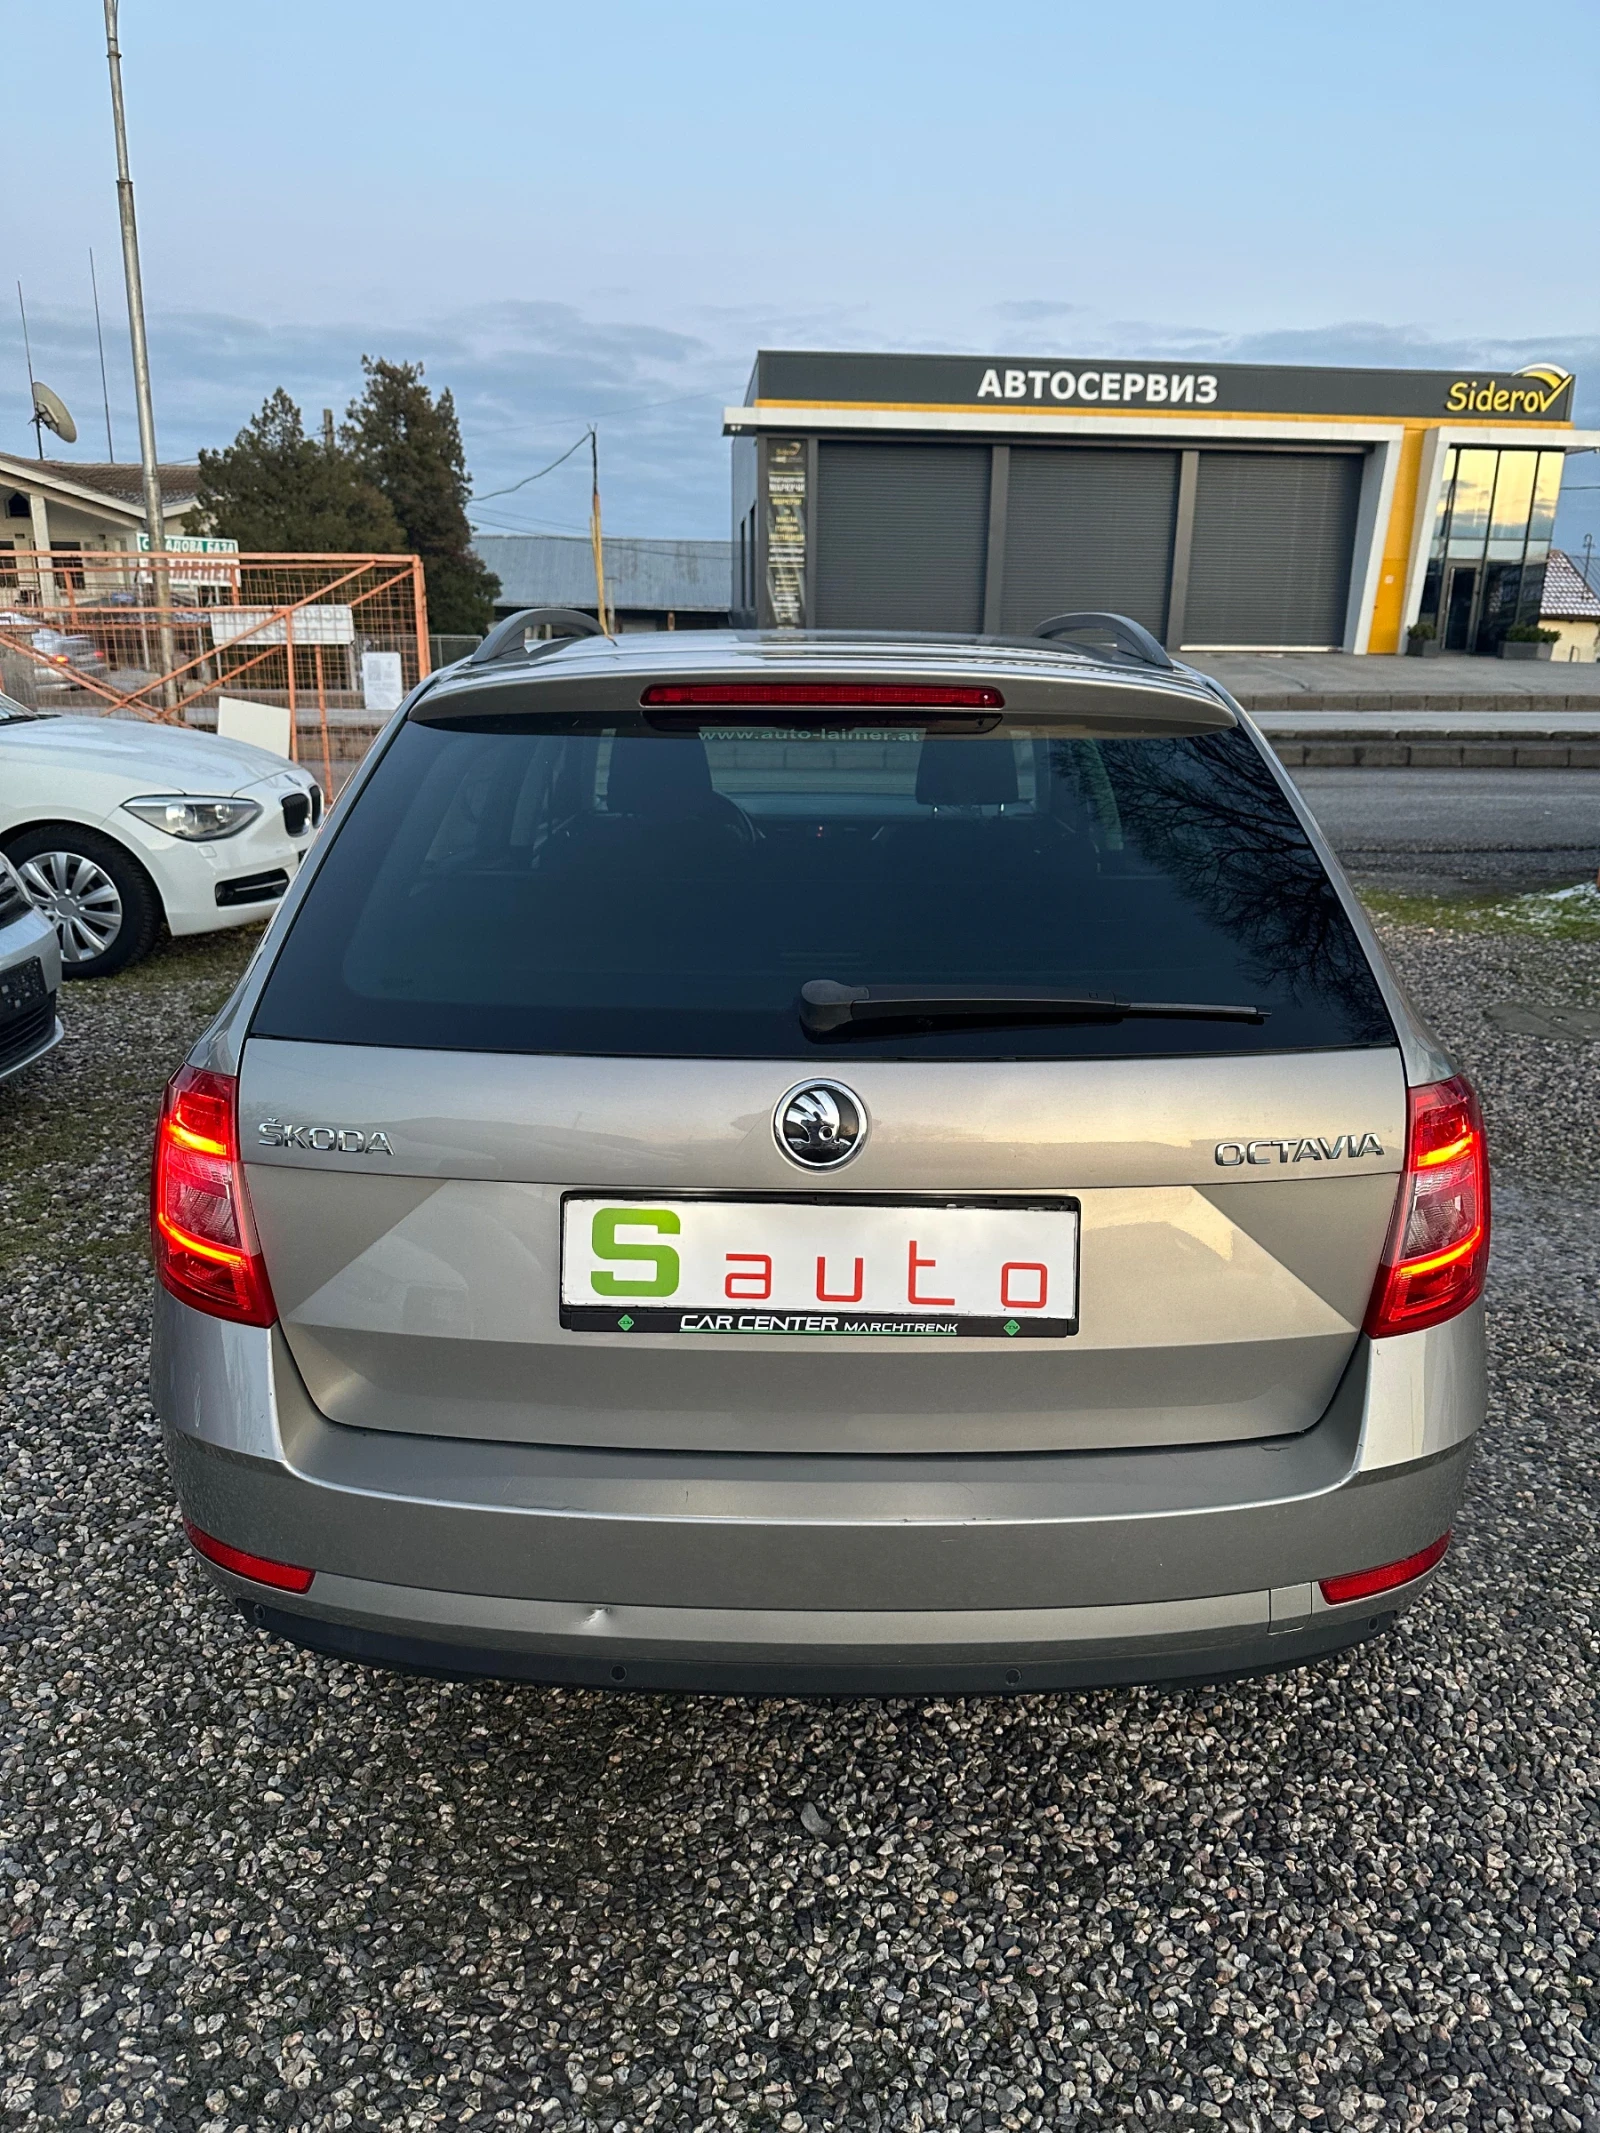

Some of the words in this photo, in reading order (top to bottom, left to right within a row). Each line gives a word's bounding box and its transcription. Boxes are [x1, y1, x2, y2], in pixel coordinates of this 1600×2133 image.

[977, 369, 1218, 404] АВТОСЕРВИЗ
[1446, 374, 1573, 412] Siderov
[141, 537, 204, 553] САДОВА
[206, 541, 235, 554] БАЗА
[698, 728, 920, 742] www.auto-laimer.at
[257, 1117, 396, 1157] ŠKODA
[1214, 1132, 1385, 1167] OCTAVIA
[680, 1315, 733, 1330] CAR
[738, 1316, 839, 1331] CENTER
[844, 1322, 959, 1333] MARCHTRENK
